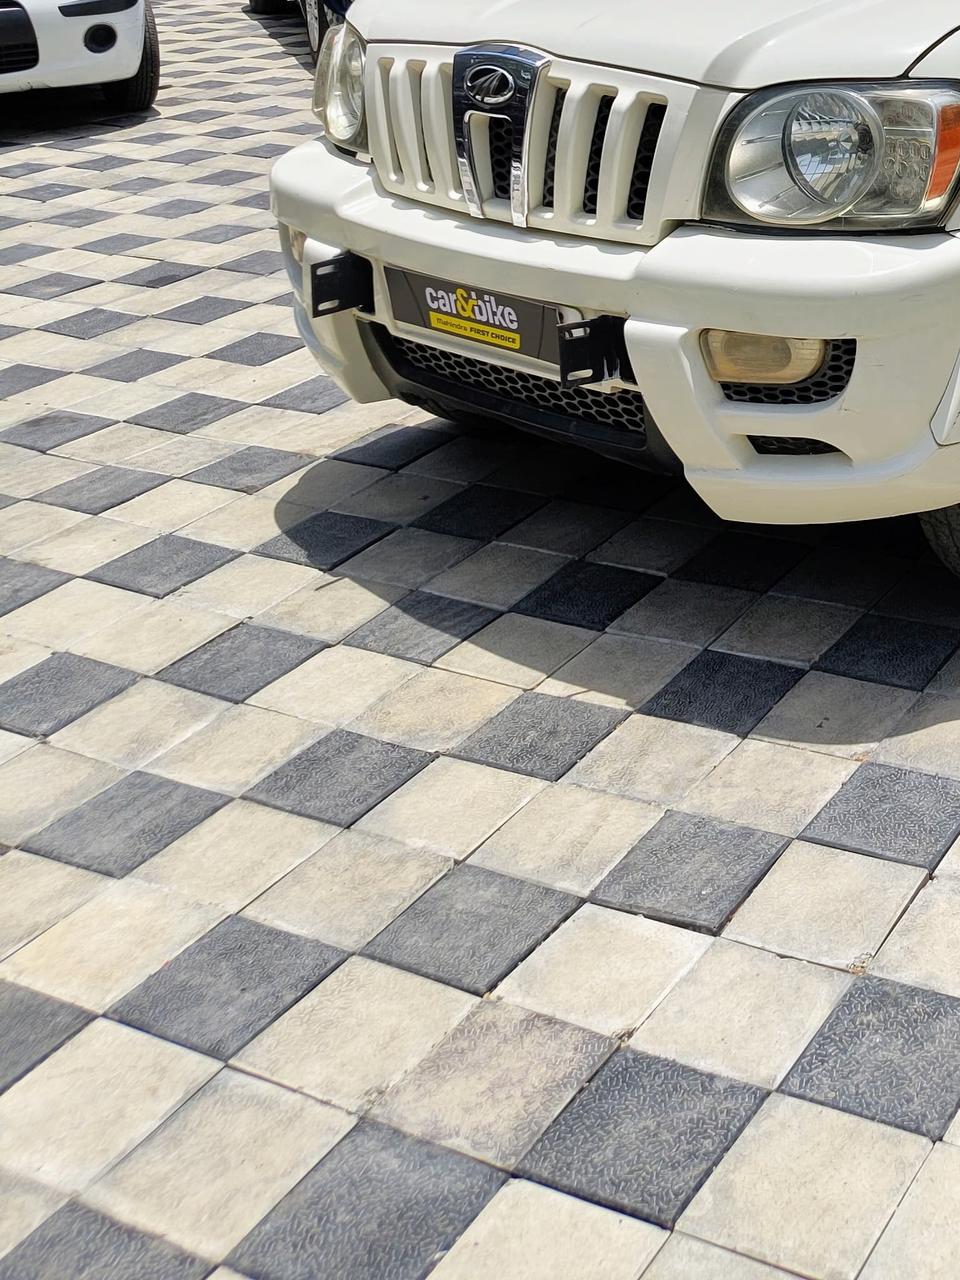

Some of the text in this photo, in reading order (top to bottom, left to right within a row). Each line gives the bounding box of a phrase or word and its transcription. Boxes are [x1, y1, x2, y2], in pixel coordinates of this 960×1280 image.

[425, 287, 519, 330] car&bike
[469, 326, 490, 337] FIRST
[490, 332, 517, 344] CHOICE
